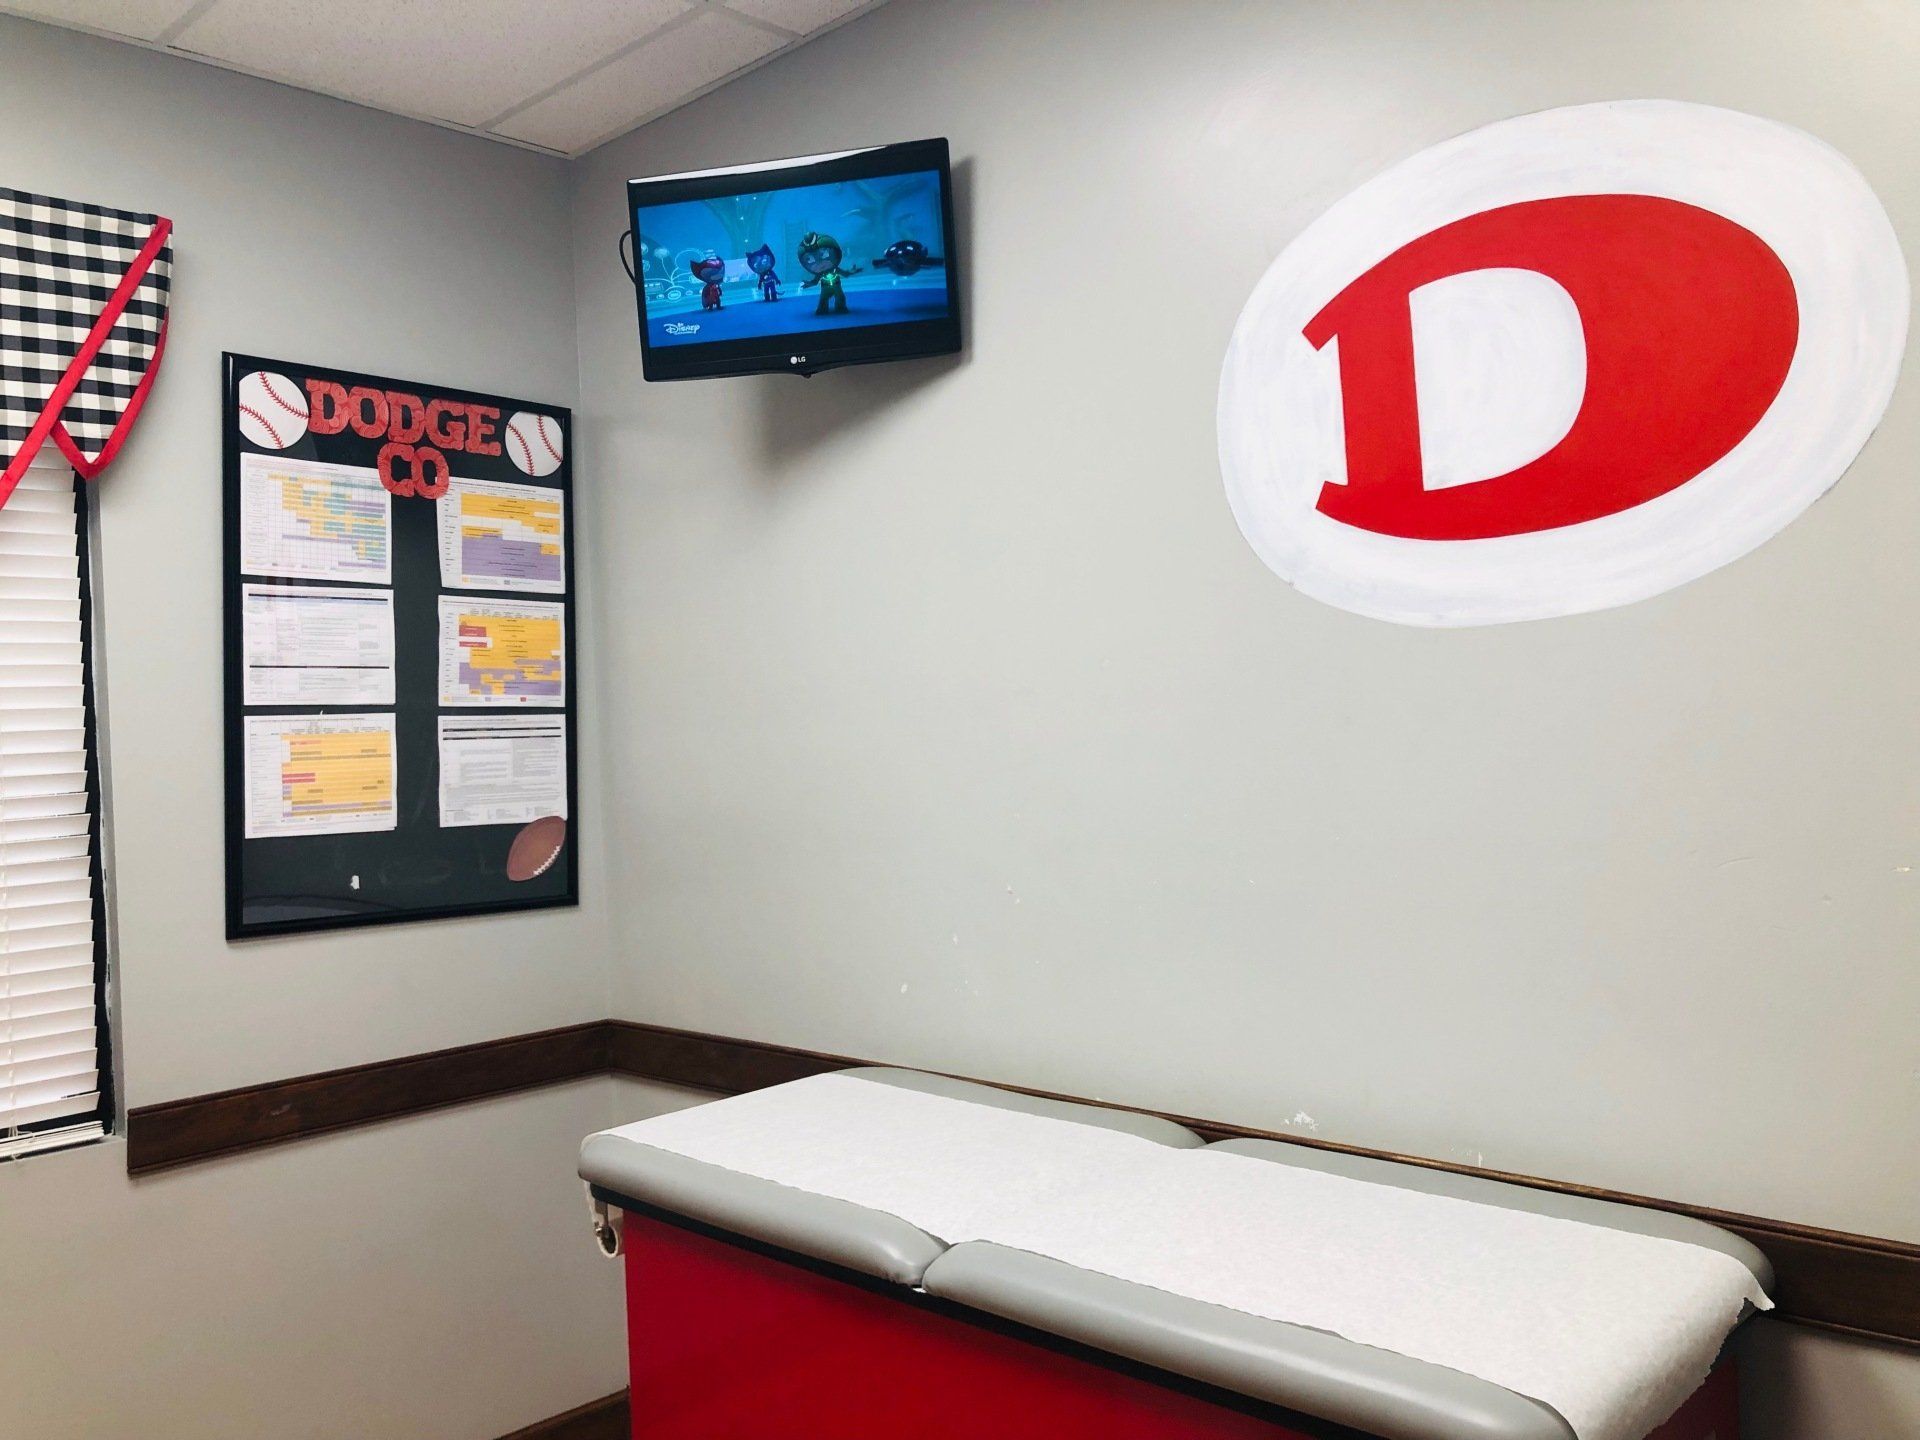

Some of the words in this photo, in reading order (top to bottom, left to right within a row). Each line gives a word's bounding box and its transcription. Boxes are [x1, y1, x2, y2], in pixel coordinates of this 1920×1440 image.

[663, 322, 700, 334] Disney
[1301, 193, 1800, 542] D
[305, 378, 501, 457] DODGE
[377, 442, 450, 500] CO
